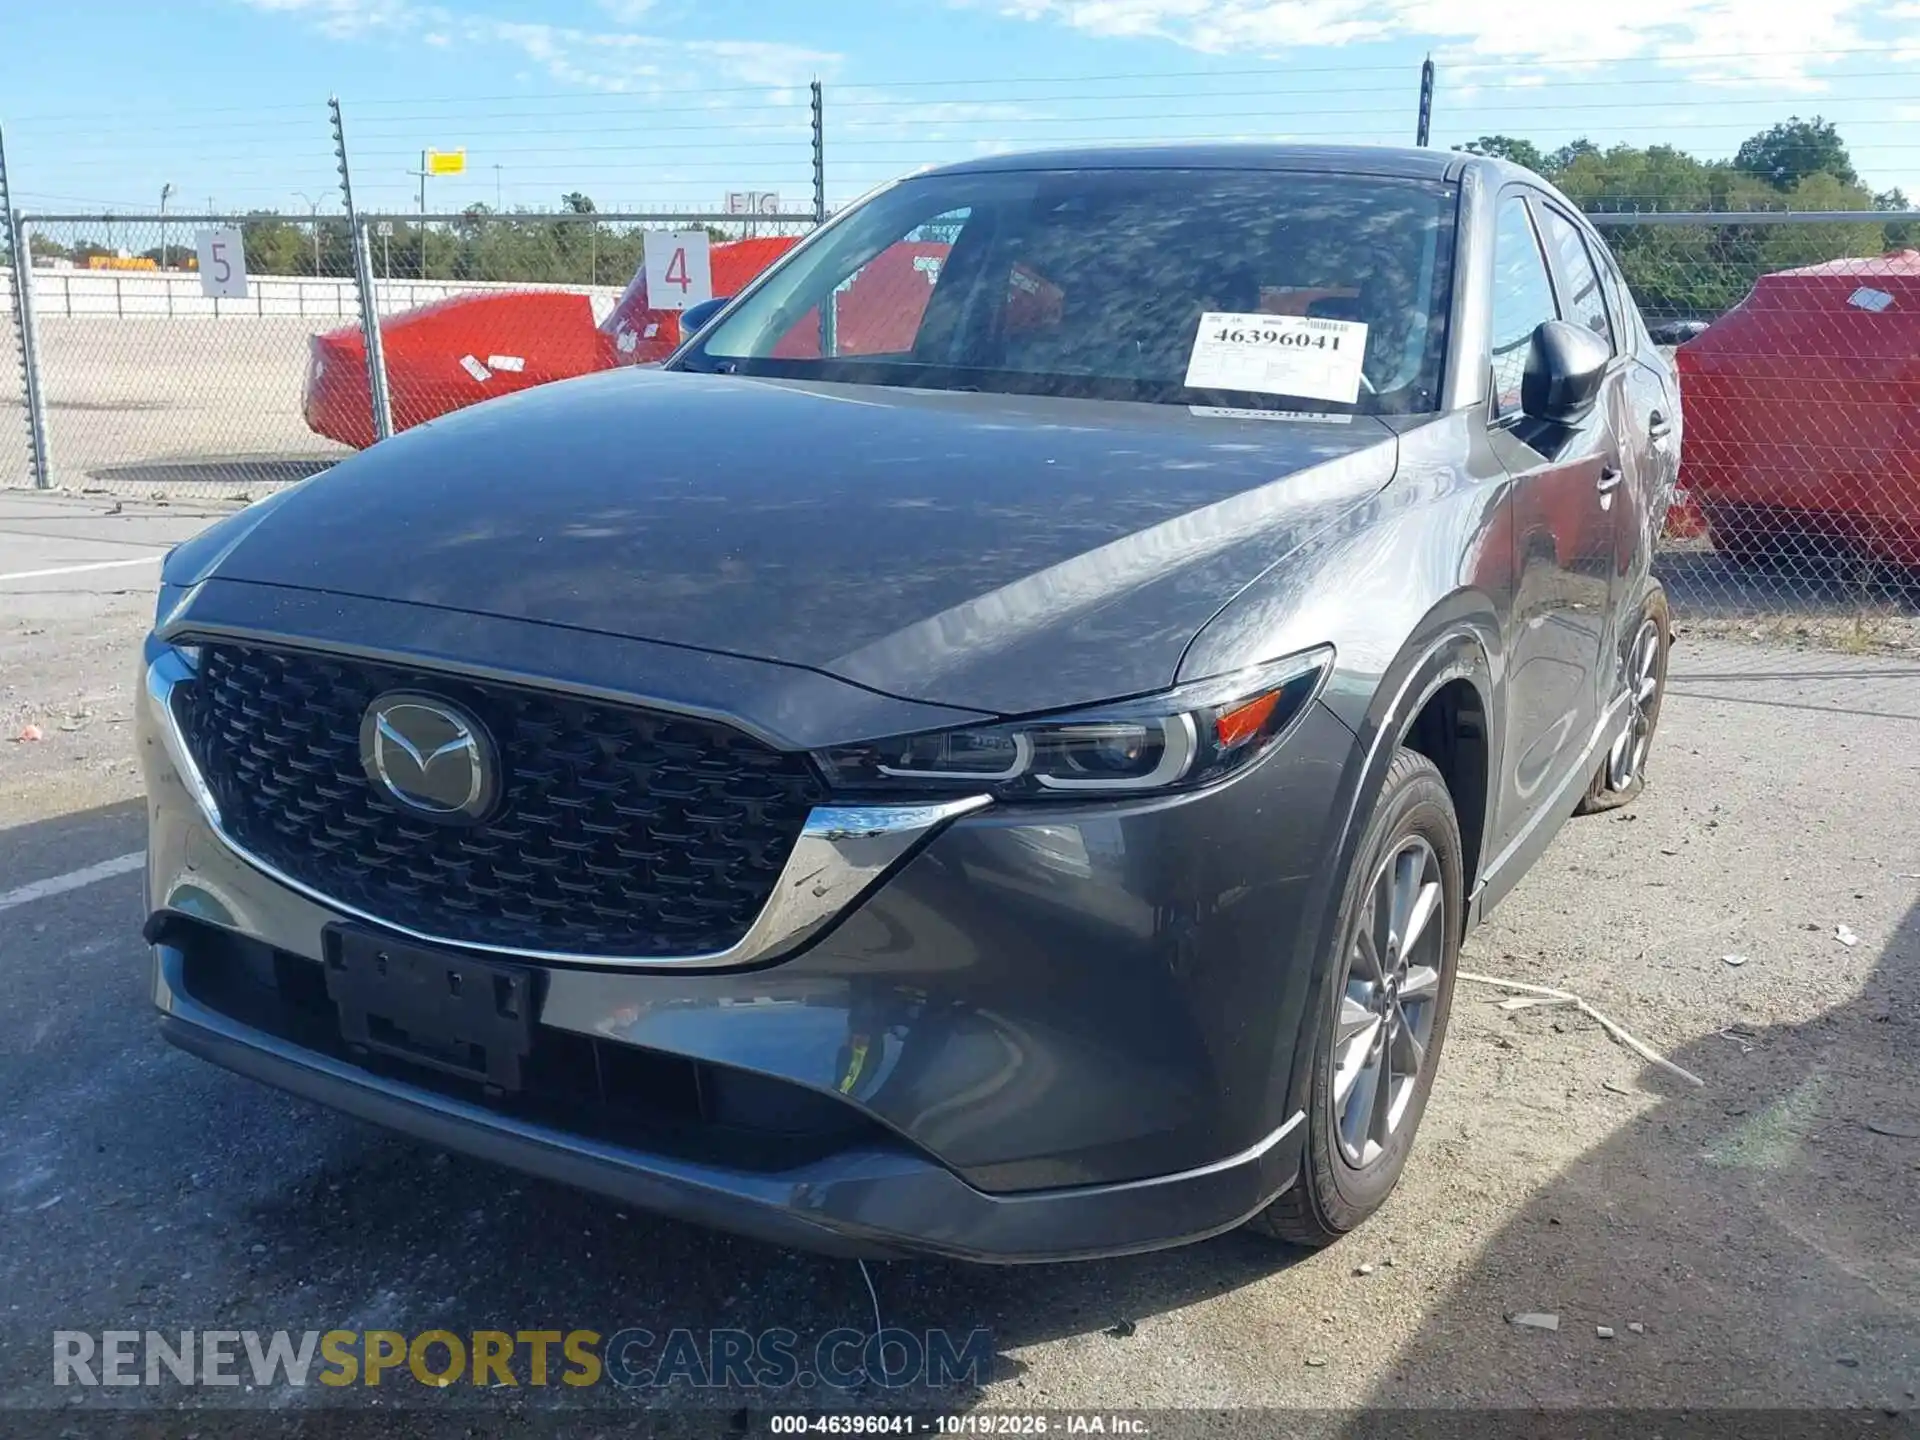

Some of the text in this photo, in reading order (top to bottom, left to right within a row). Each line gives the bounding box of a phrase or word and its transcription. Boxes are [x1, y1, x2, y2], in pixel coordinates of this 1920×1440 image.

[212, 243, 230, 282] 5
[665, 248, 691, 293] 4
[1213, 328, 1339, 350] 46396041
